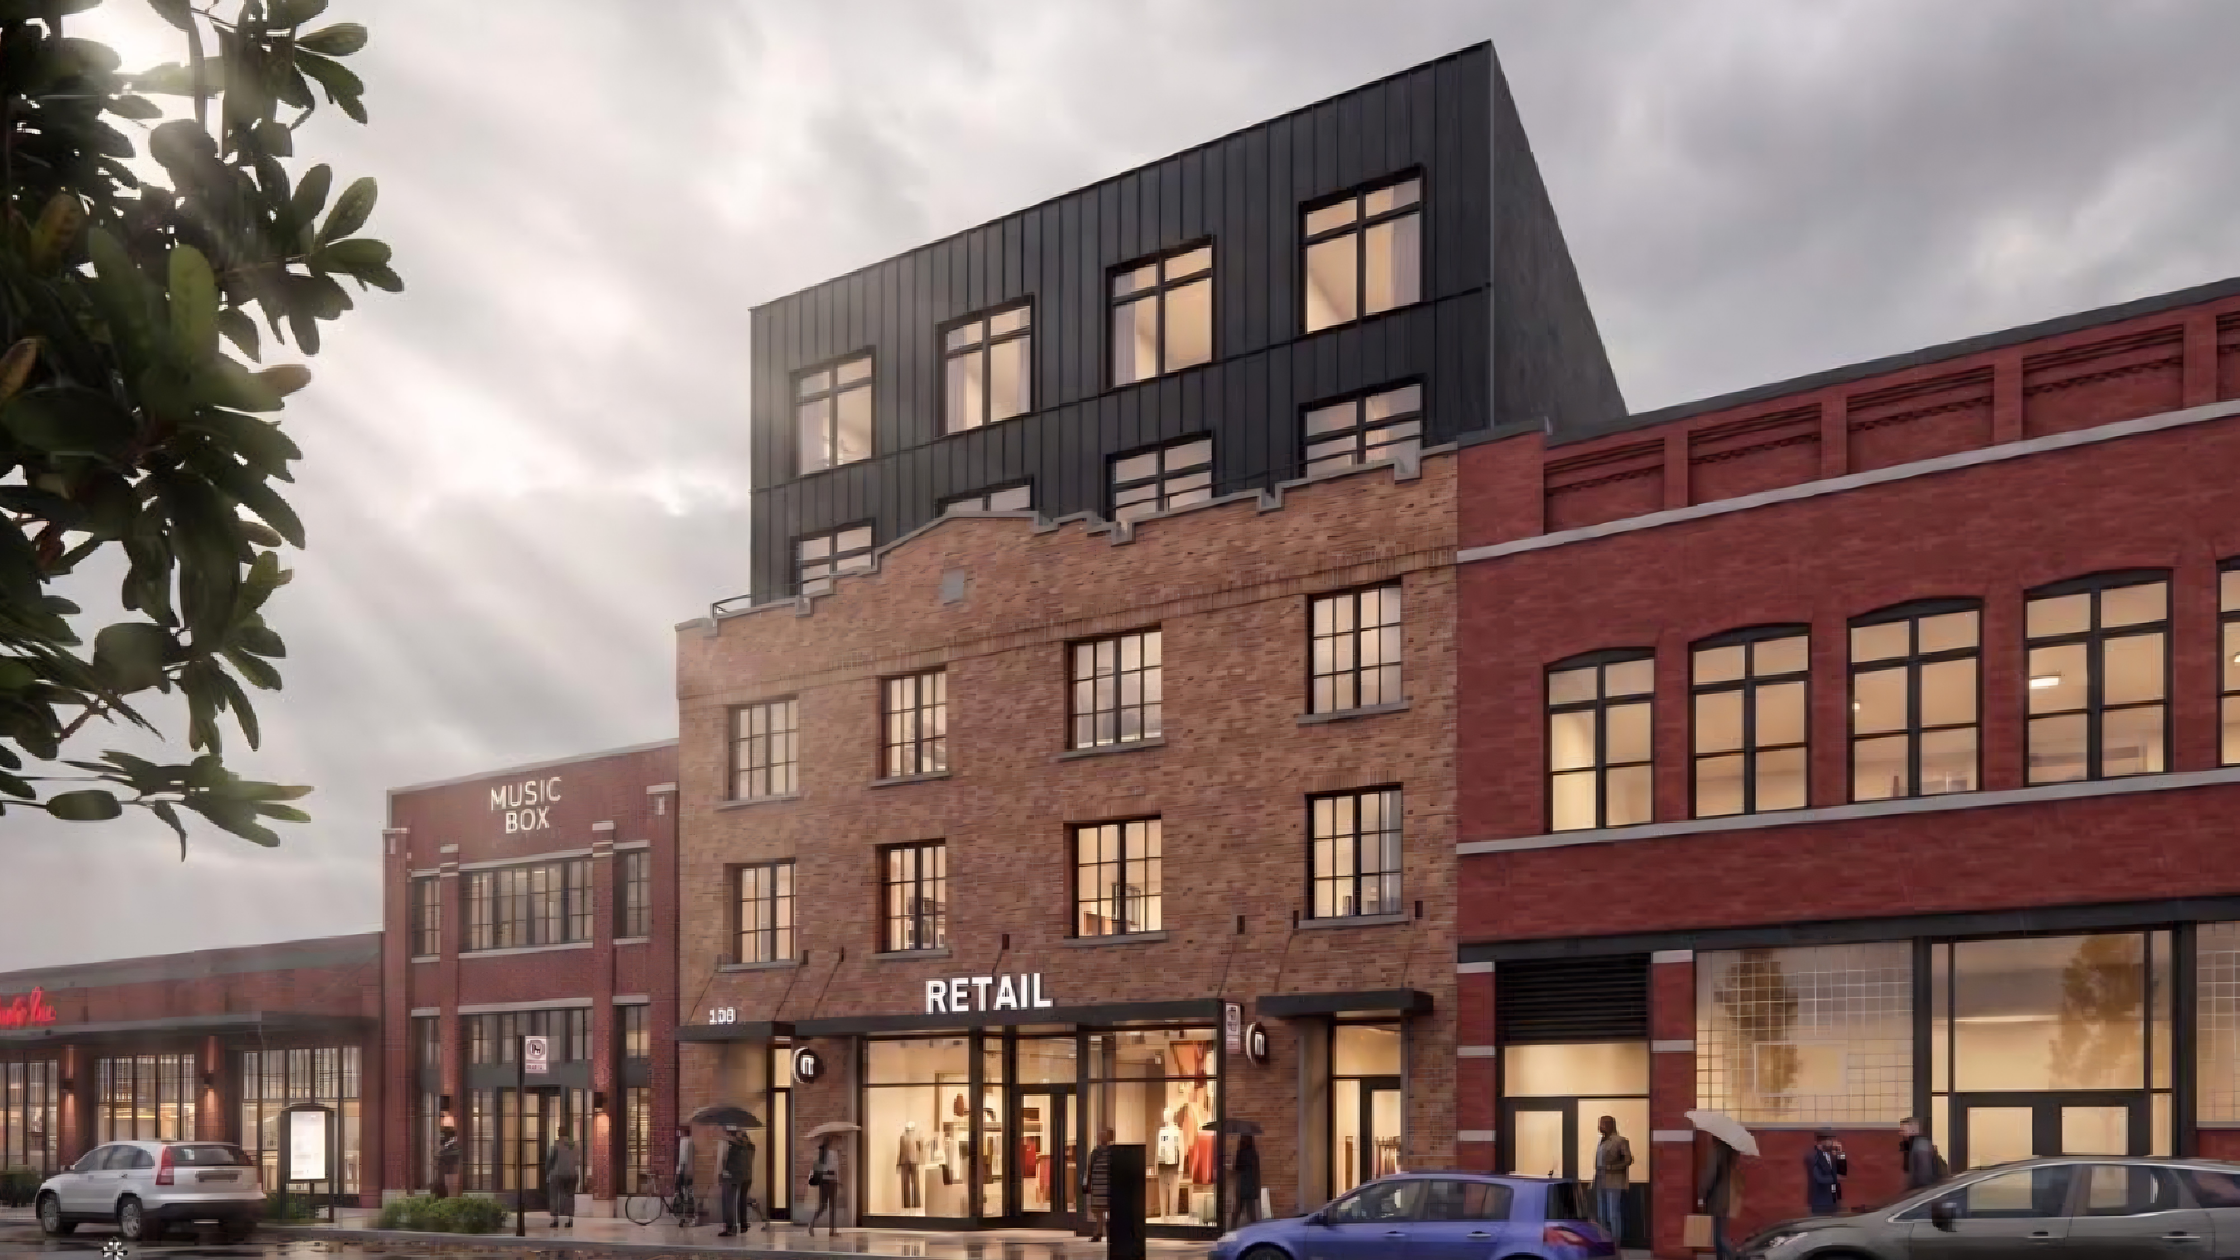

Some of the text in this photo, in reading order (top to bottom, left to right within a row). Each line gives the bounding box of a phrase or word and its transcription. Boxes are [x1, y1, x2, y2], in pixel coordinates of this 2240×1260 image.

[490, 776, 562, 811] MUSIC
[505, 806, 550, 834] BOX
[925, 972, 1053, 1015] RETAIL
